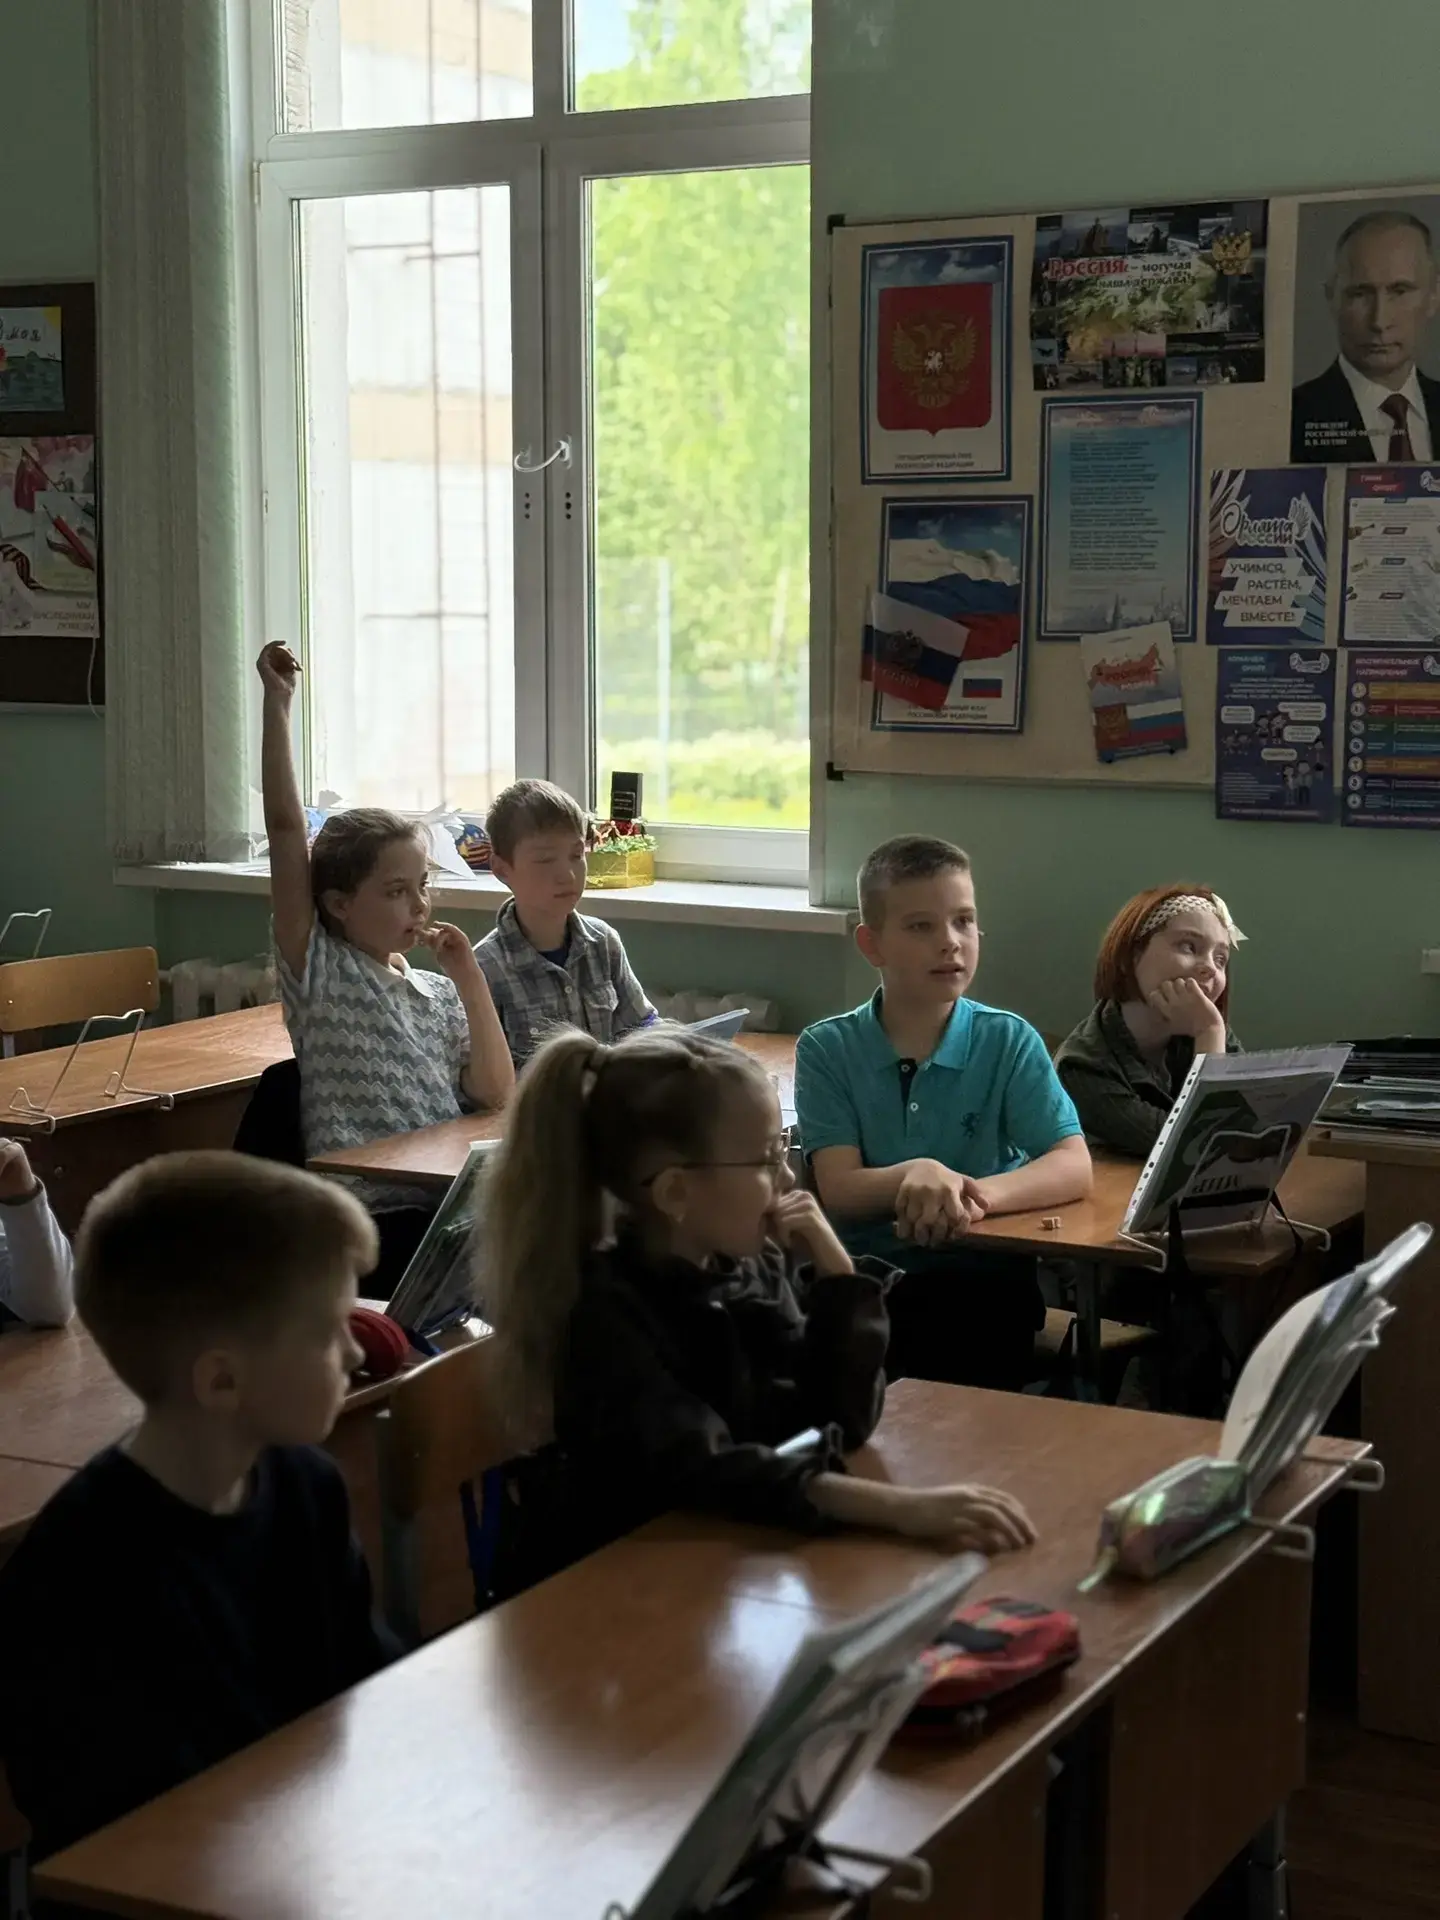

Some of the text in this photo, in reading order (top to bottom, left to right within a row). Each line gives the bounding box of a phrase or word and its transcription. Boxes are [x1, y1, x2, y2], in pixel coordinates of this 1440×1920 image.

[1222, 502, 1294, 539] Орлята
[1230, 563, 1286, 574] УЧИМСЯ,
[1222, 595, 1282, 605] МЕЧТАЕМ
[1240, 611, 1296, 622] ВМЕСТЕ!
